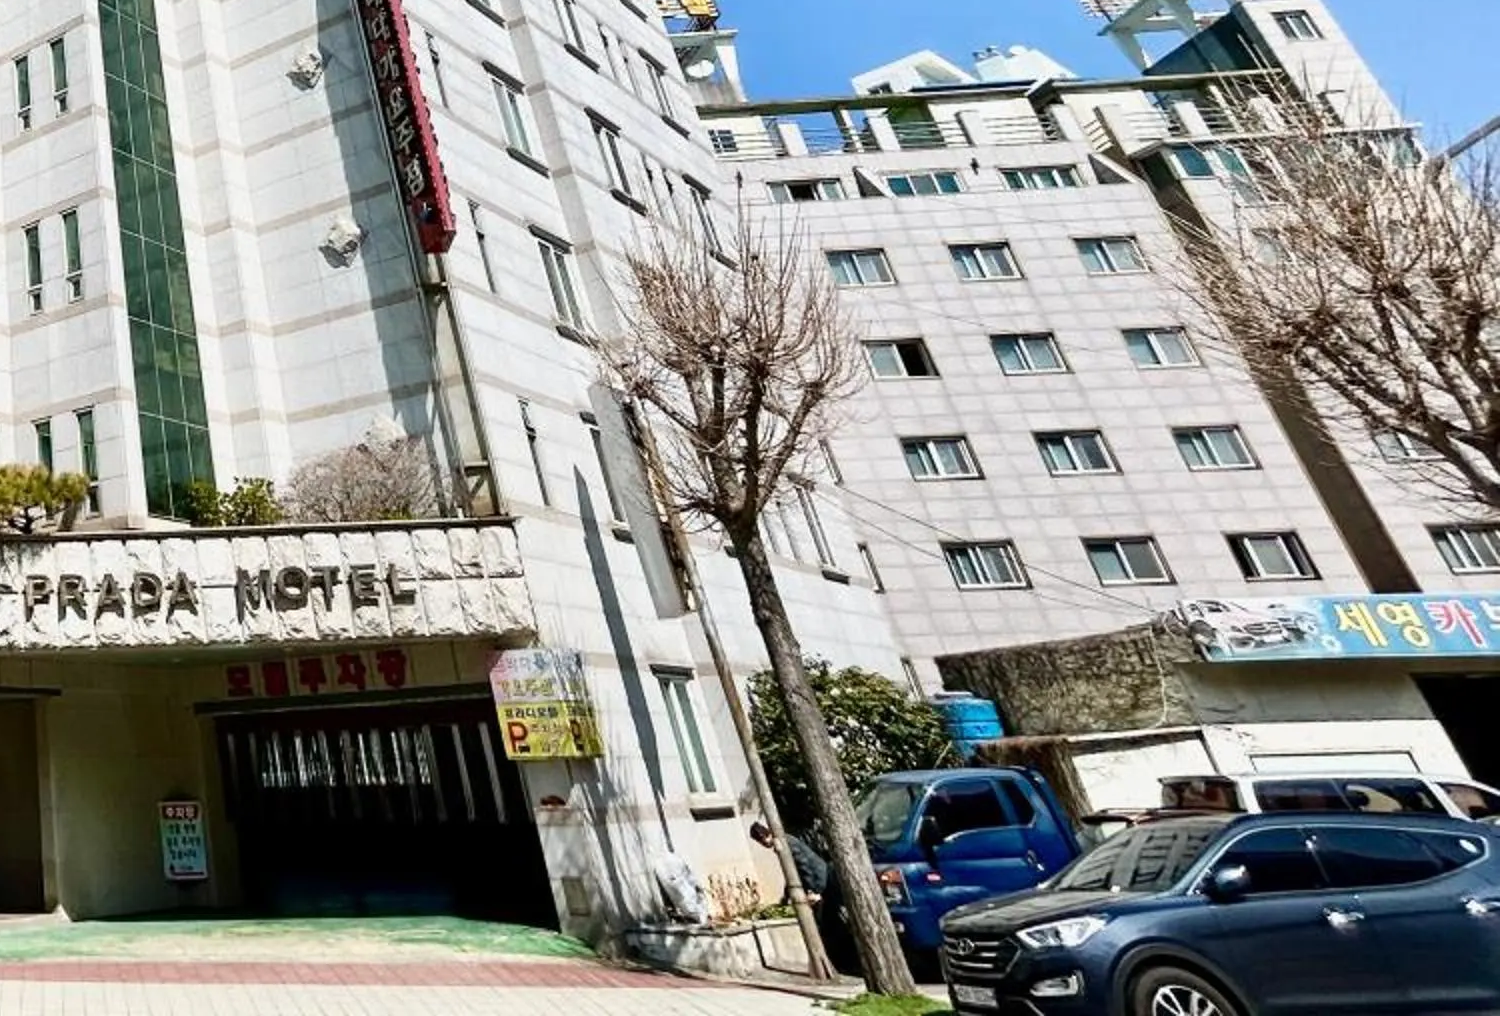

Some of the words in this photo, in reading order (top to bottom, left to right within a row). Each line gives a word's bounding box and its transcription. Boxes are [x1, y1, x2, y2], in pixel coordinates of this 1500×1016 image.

[24, 572, 199, 616] PRADA
[235, 563, 416, 612] MOTEL
[507, 721, 529, 754] P
